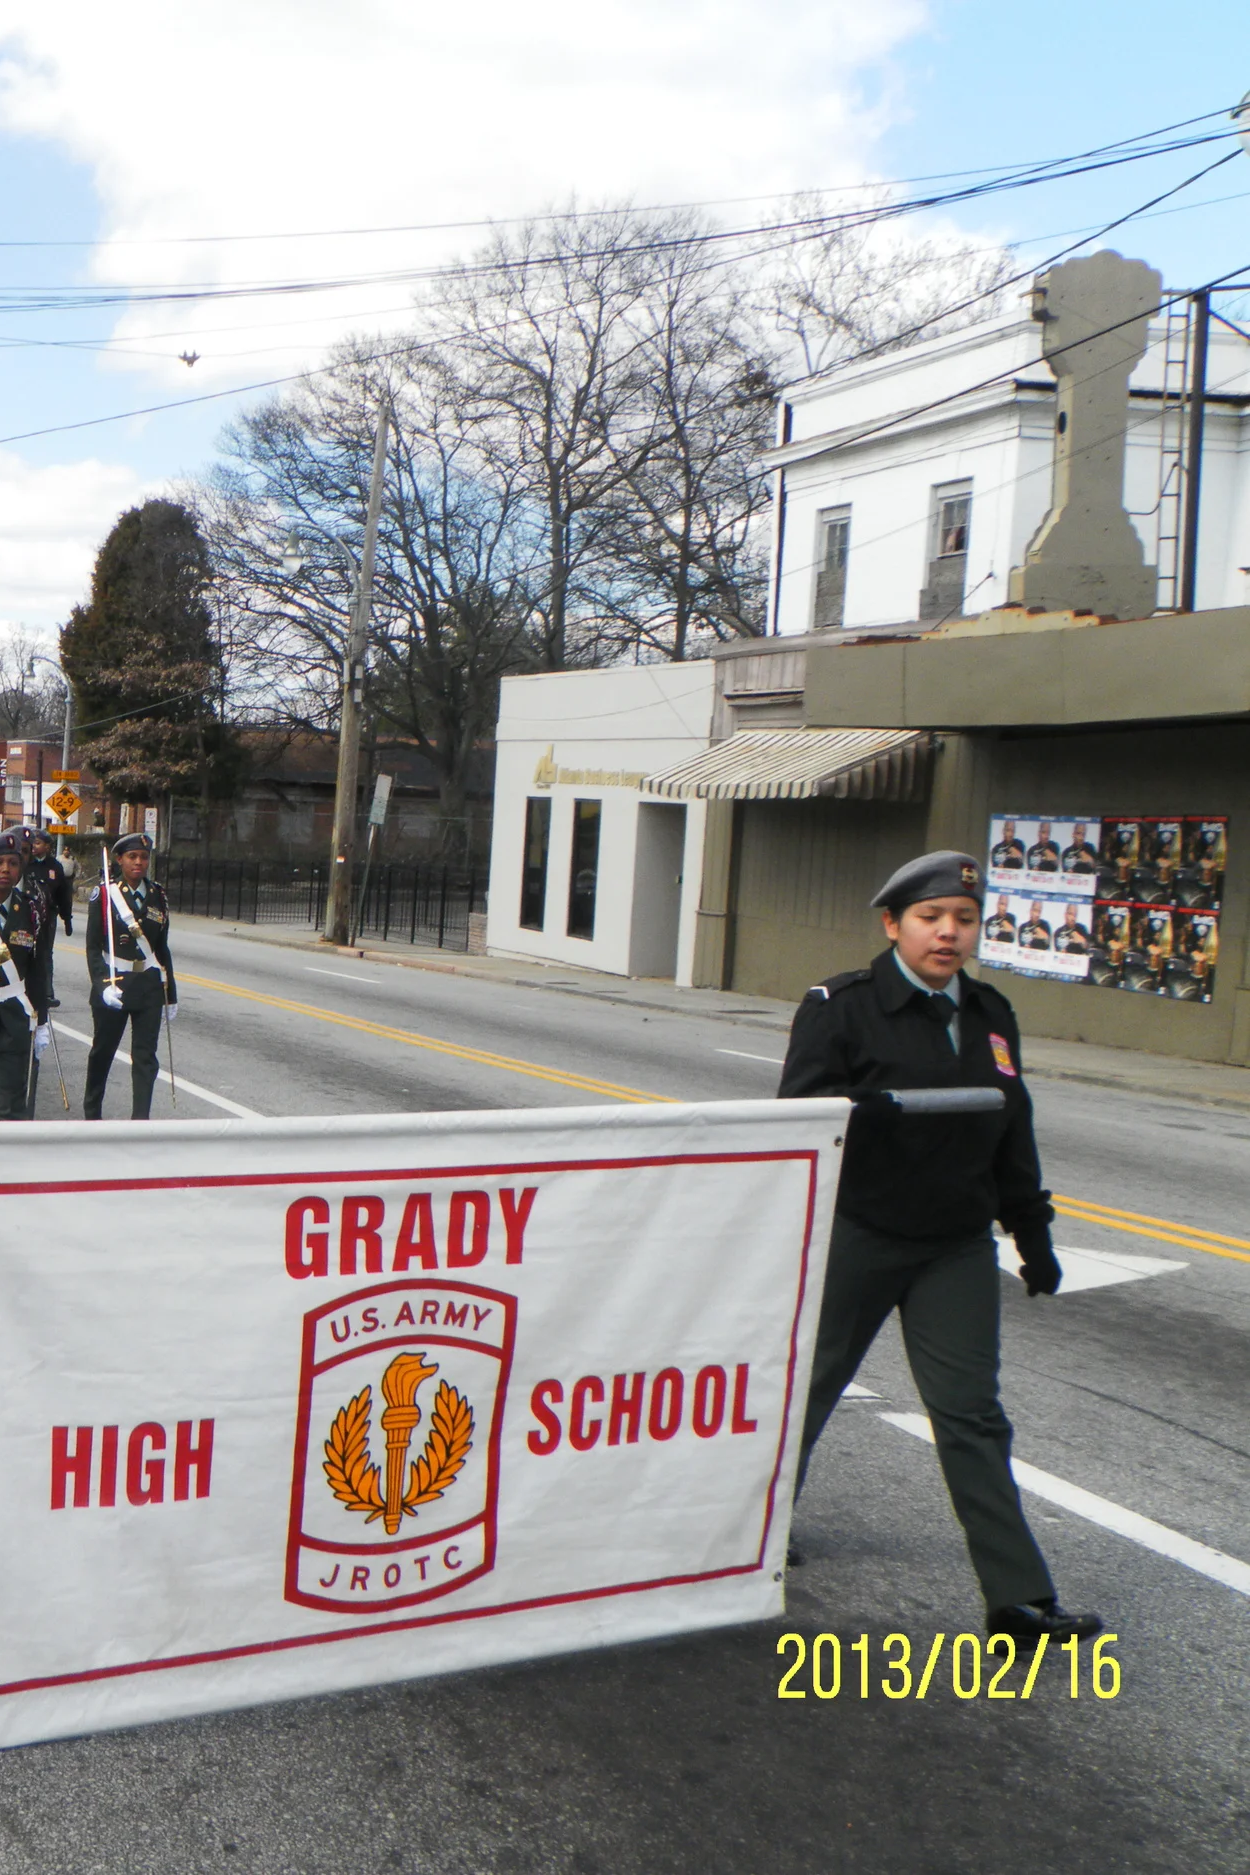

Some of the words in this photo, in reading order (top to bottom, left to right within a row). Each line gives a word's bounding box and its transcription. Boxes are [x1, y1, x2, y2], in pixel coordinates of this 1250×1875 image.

[52, 796, 75, 807] 12-9
[620, 769, 649, 789] Leag
[285, 1187, 538, 1279] GRADY
[330, 1307, 387, 1343] U.S.
[393, 1299, 494, 1332] ARMY
[527, 1362, 758, 1456] SCHOOL
[50, 1418, 215, 1510] HIGH
[319, 1545, 463, 1591] JROTC
